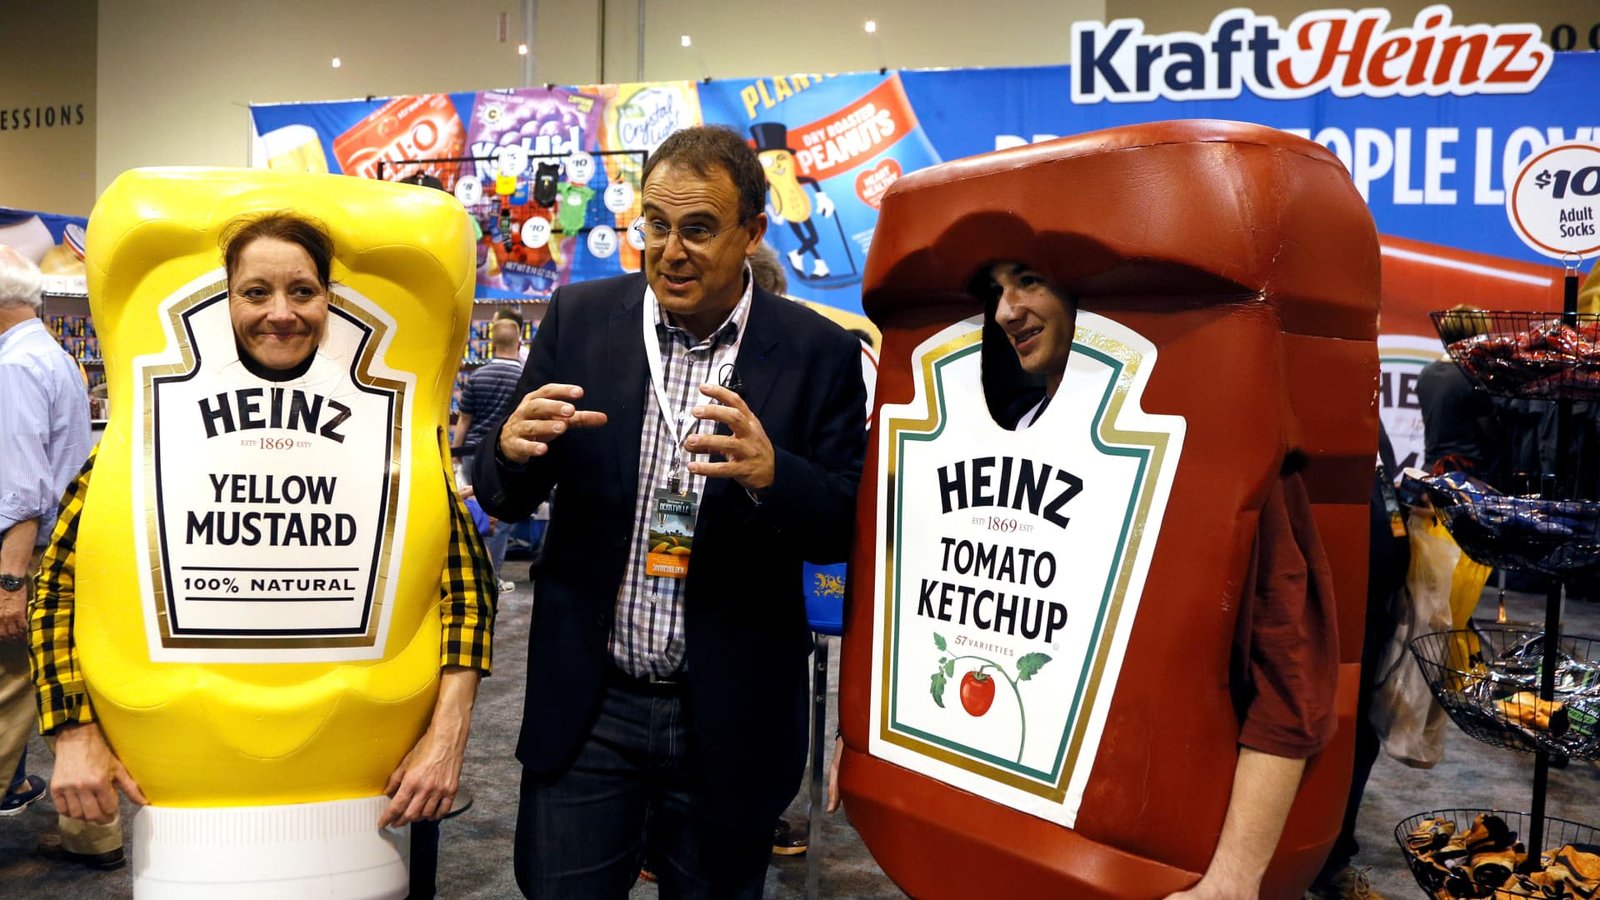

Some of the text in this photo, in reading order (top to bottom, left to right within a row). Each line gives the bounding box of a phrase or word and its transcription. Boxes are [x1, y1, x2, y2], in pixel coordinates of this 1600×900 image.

[802, 102, 876, 147] DRY ROASTED
[796, 109, 895, 175] PEANUTS
[1535, 166, 1600, 199] $10
[1560, 207, 1593, 223] Adult
[1560, 222, 1595, 238] Socks
[197, 387, 352, 444] HEINZ
[260, 437, 294, 450] 1869
[208, 474, 337, 505] YELLOW
[937, 456, 1084, 530] HEINZ
[185, 511, 357, 547] MUSTARD
[987, 516, 1018, 533] 1869
[941, 537, 1057, 589] TOMATO
[184, 577, 356, 594] 100% NATURAL
[917, 578, 1068, 643] KETCHUP
[954, 635, 1015, 657] 57 VARIETIES
